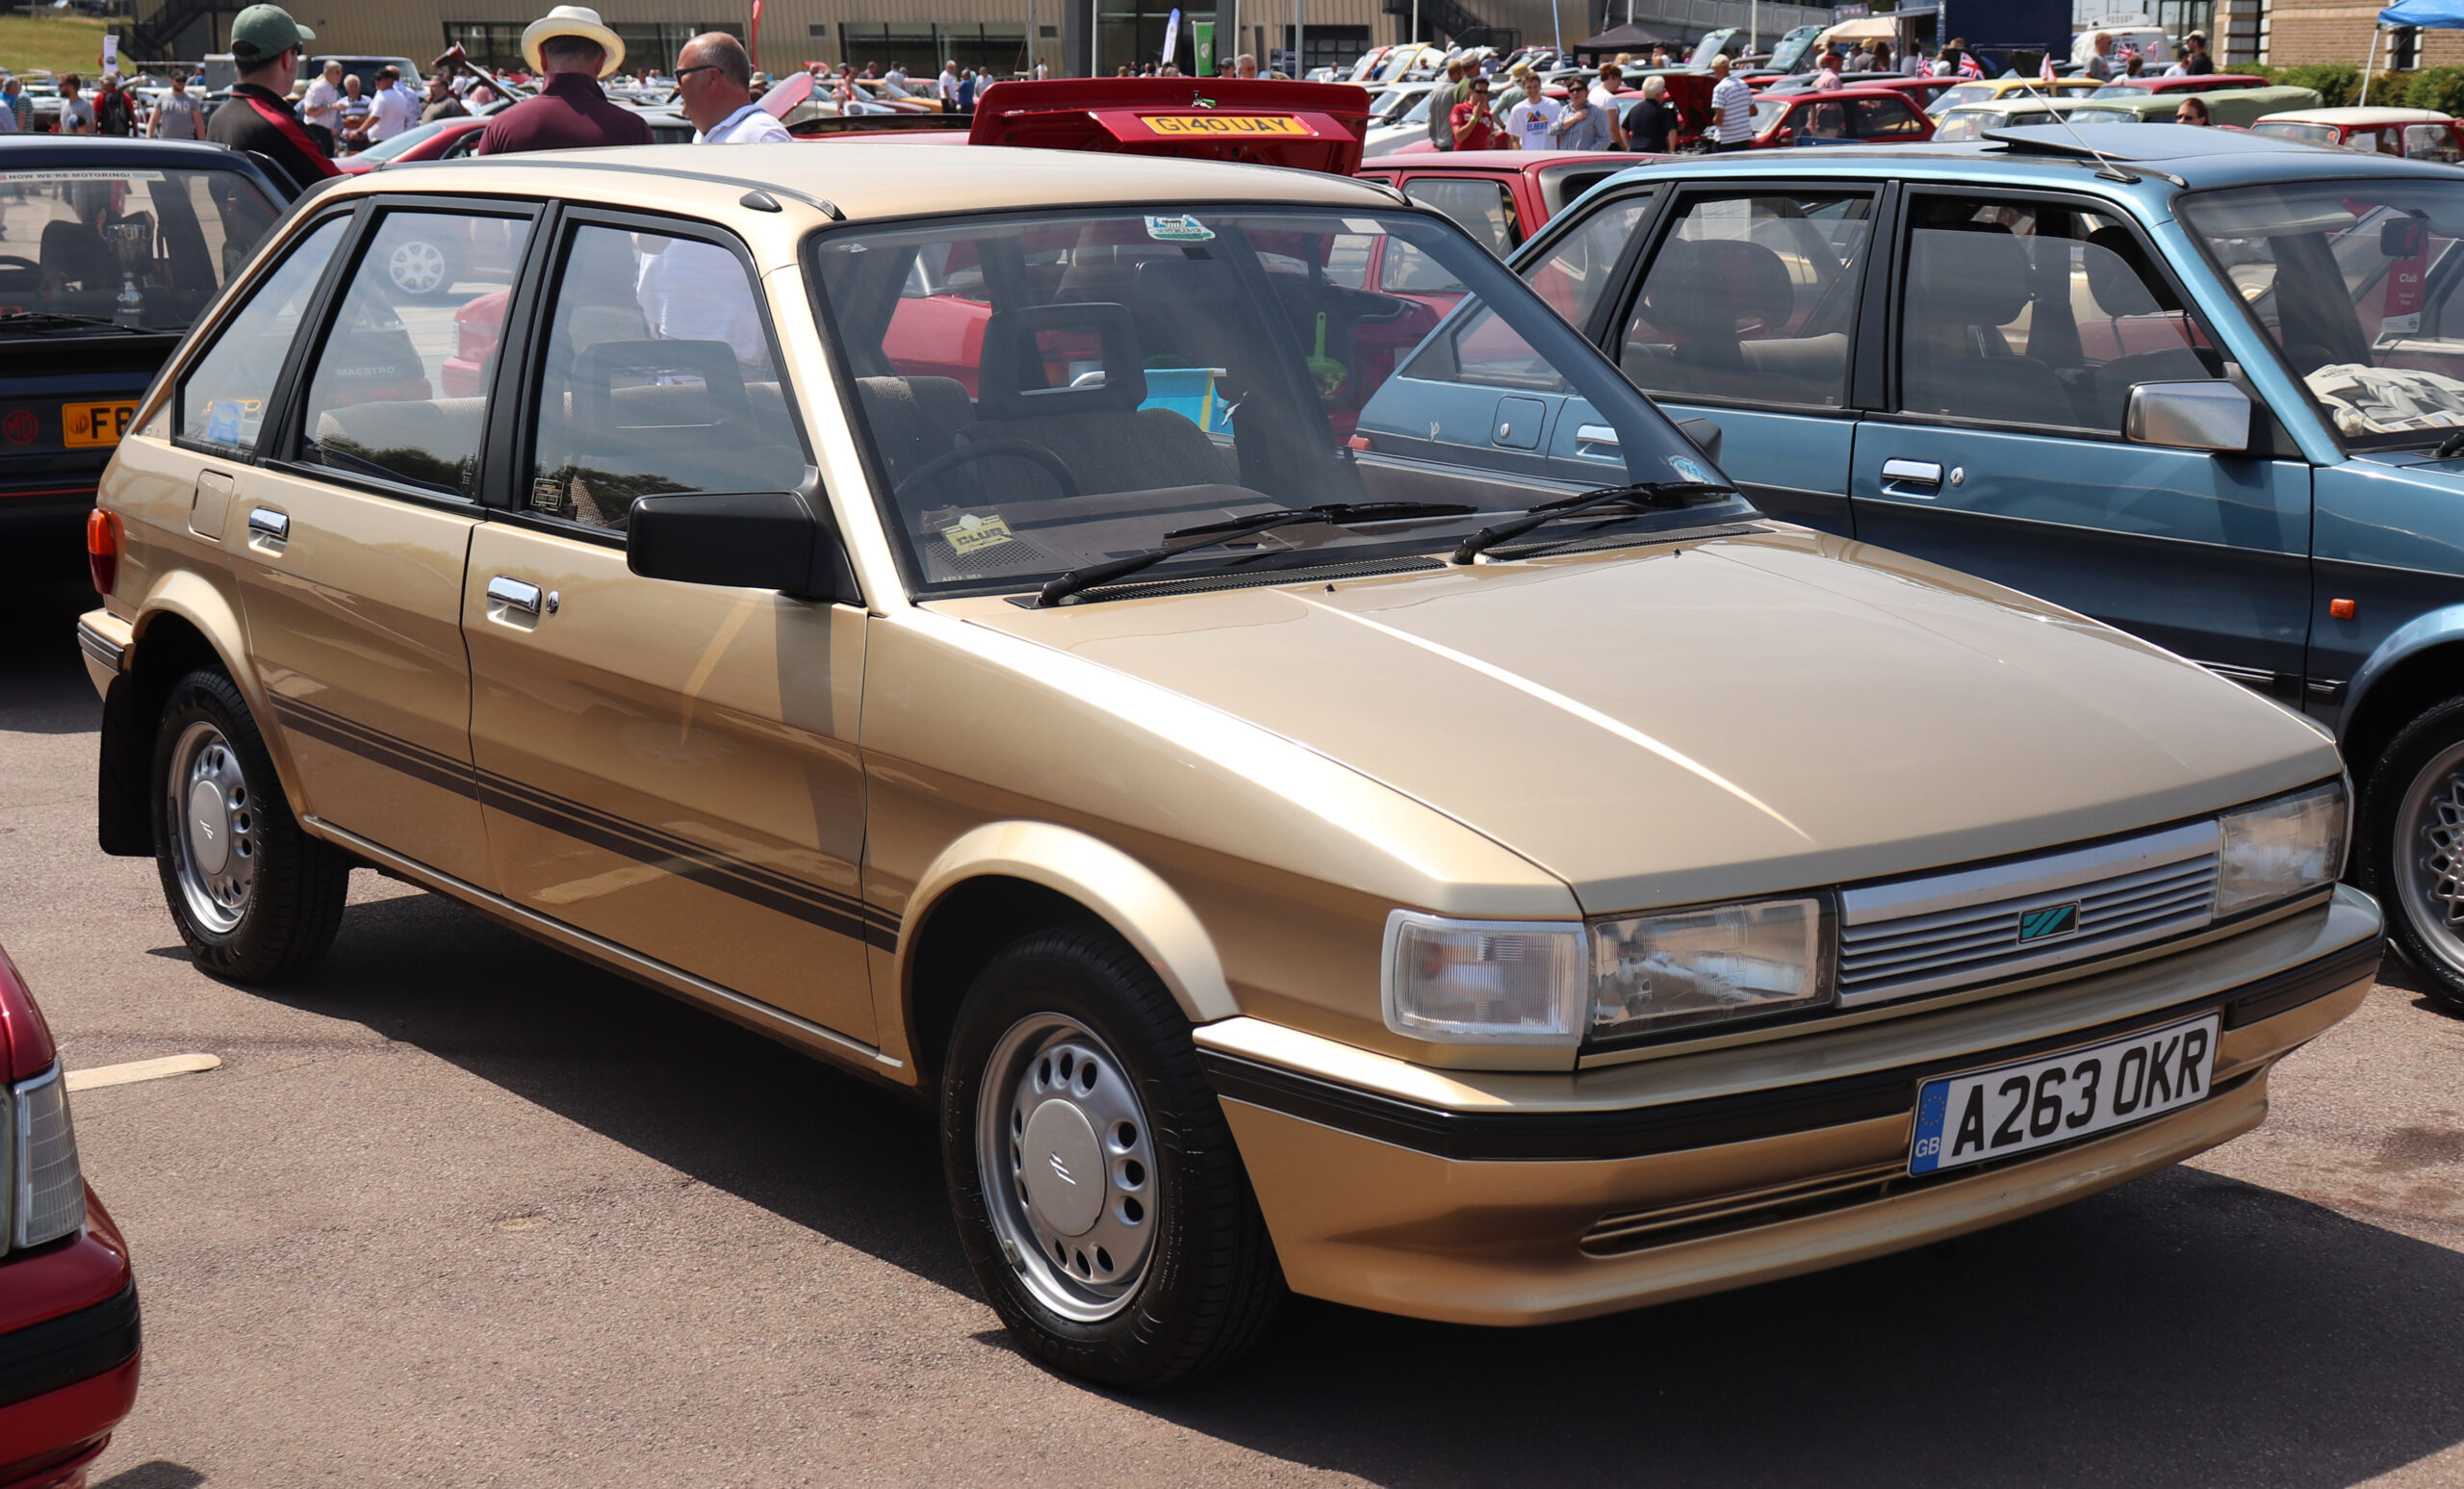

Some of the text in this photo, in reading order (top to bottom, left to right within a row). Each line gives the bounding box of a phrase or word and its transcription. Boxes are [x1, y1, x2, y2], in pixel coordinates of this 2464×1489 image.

[1155, 117, 1290, 132] G140 UAY
[336, 366, 396, 377] MAESTRO
[1951, 1027, 2209, 1157] A263 OKR
[1915, 1136, 1940, 1158] GB
